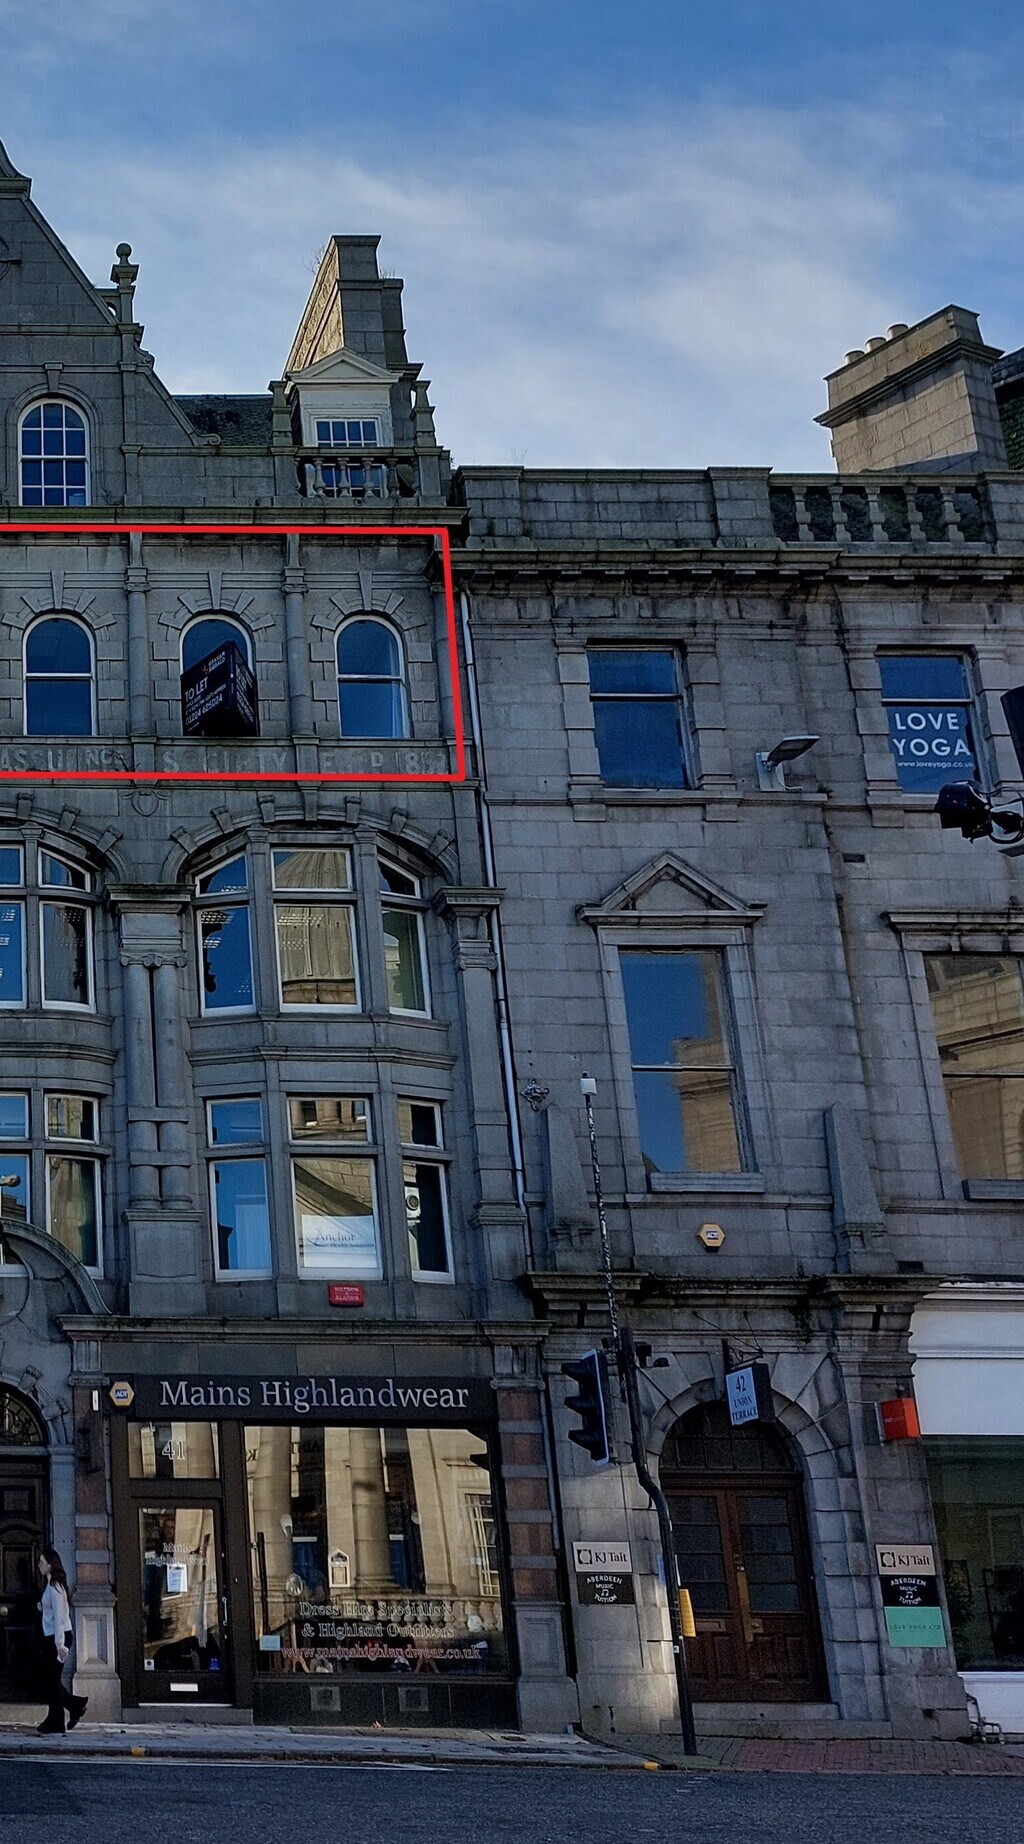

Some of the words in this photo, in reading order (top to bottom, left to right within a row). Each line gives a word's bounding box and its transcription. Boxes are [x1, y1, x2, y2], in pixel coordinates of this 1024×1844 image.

[185, 687, 195, 703] TO
[196, 676, 209, 695] LET
[894, 712, 960, 731] LOVE
[892, 738, 972, 756] YOGA
[316, 1228, 356, 1242] Anchor
[735, 1374, 747, 1393] 42
[160, 1380, 251, 1406] Mains
[259, 1379, 469, 1413] Highlandwear
[734, 1395, 753, 1409] UNION
[732, 1406, 757, 1421] TERRACE
[162, 1439, 185, 1460] 41
[595, 1551, 607, 1564] KJ
[608, 1551, 627, 1562] Tait
[898, 1555, 910, 1567] KJ
[910, 1555, 930, 1566] Tait
[586, 1575, 623, 1584] ABERDEEN
[890, 1577, 926, 1587] ABERDEEN
[594, 1593, 618, 1603] TUITION
[899, 1595, 922, 1605] TUITION
[299, 1601, 341, 1617] Dress
[343, 1601, 374, 1617] Hire
[378, 1601, 453, 1619] Specialists
[301, 1623, 314, 1638] &
[318, 1622, 383, 1641] Highland
[387, 1622, 455, 1638] Outfitters
